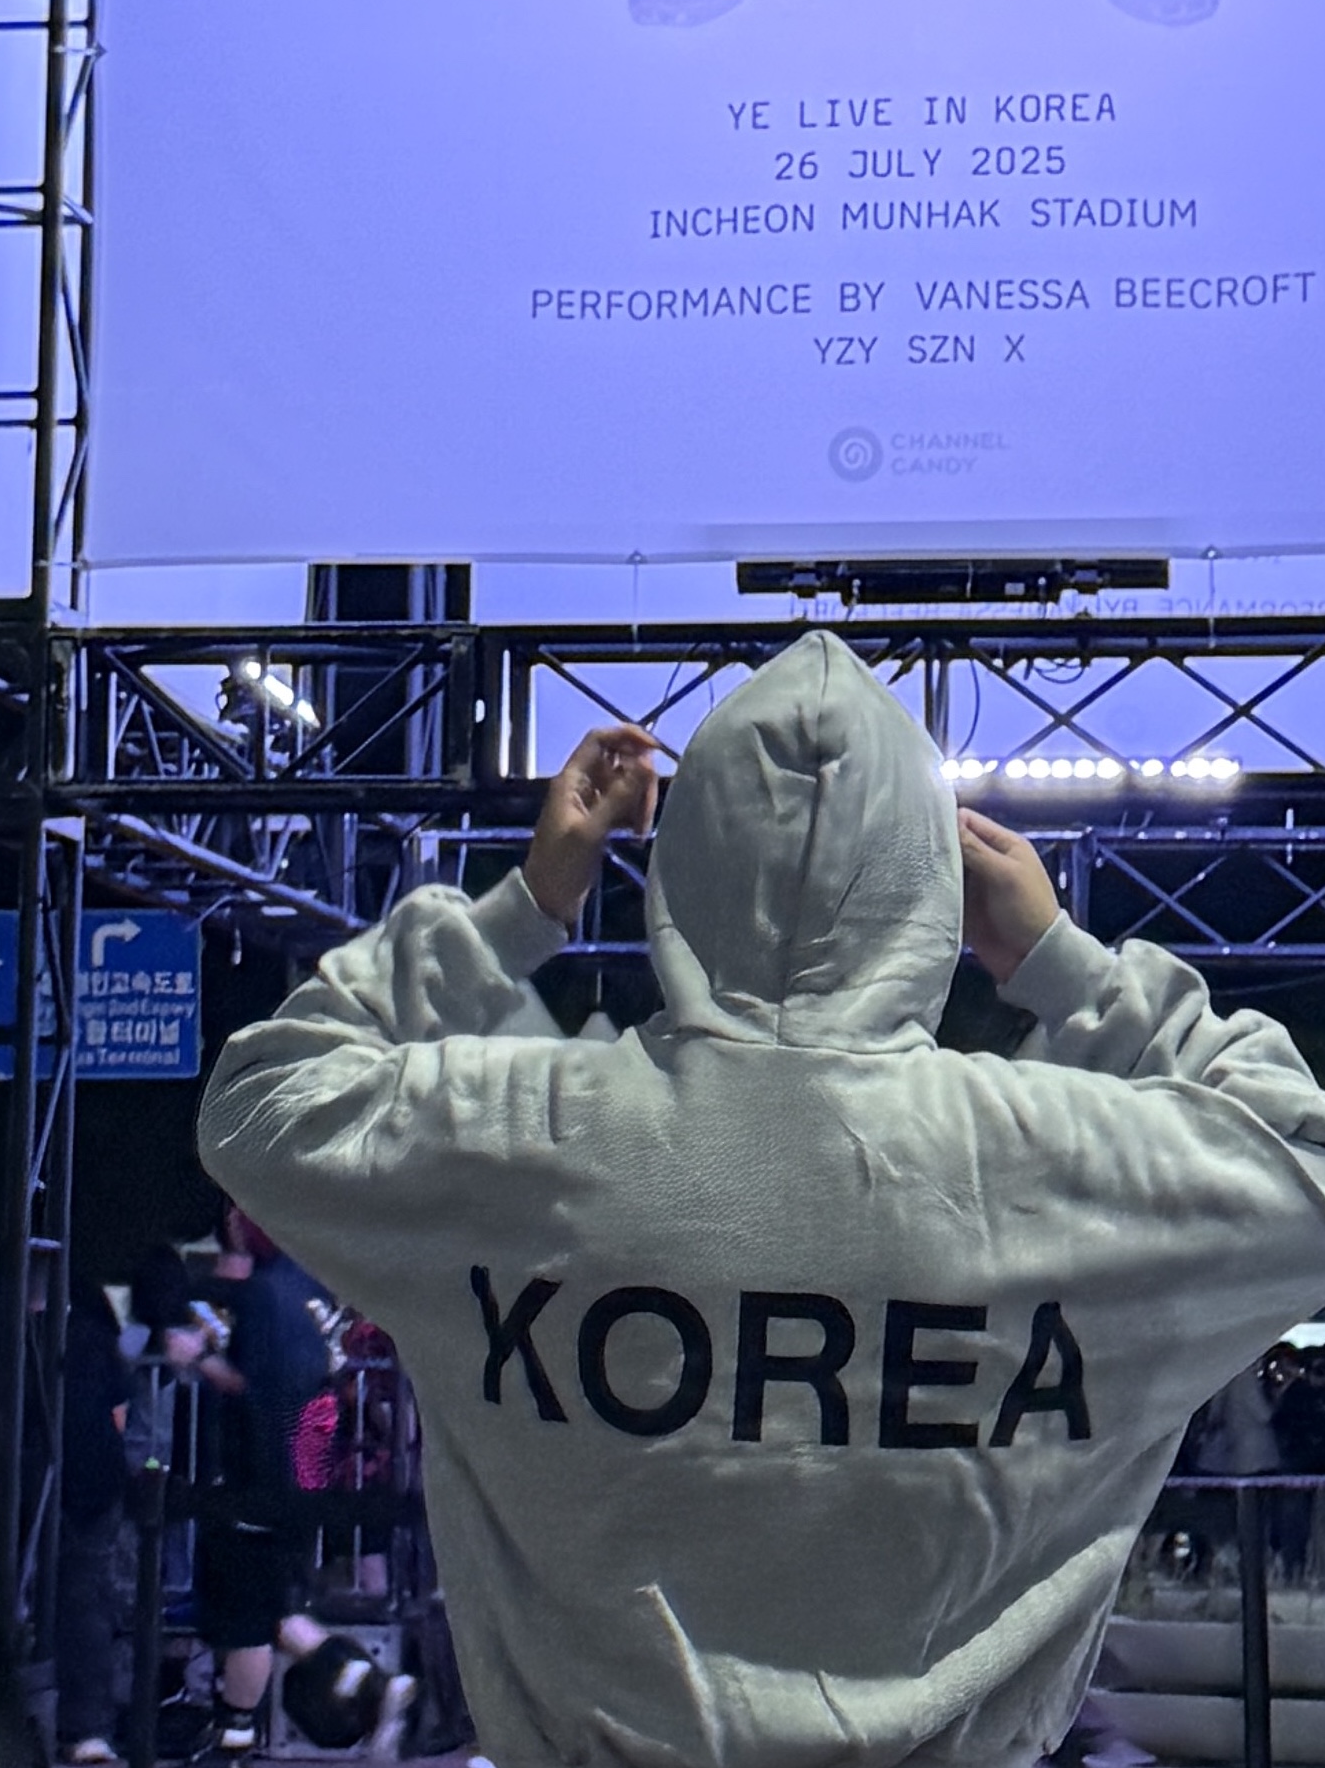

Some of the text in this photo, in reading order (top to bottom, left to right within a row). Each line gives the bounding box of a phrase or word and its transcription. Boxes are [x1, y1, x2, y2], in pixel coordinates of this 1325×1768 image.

[727, 92, 1116, 131] YE LIVE IN KOREA
[774, 145, 1067, 181] 26 JULY 2025
[649, 197, 1198, 239] INCHEON MUNHAK STADIUM
[531, 271, 1317, 321] PERFORMANCE BY VANESSA BEECROFT
[813, 333, 1027, 366] YZY SZN X
[889, 432, 1012, 451] CHANNEL
[889, 456, 978, 476] CANDY
[470, 1265, 1094, 1449] KOREA
